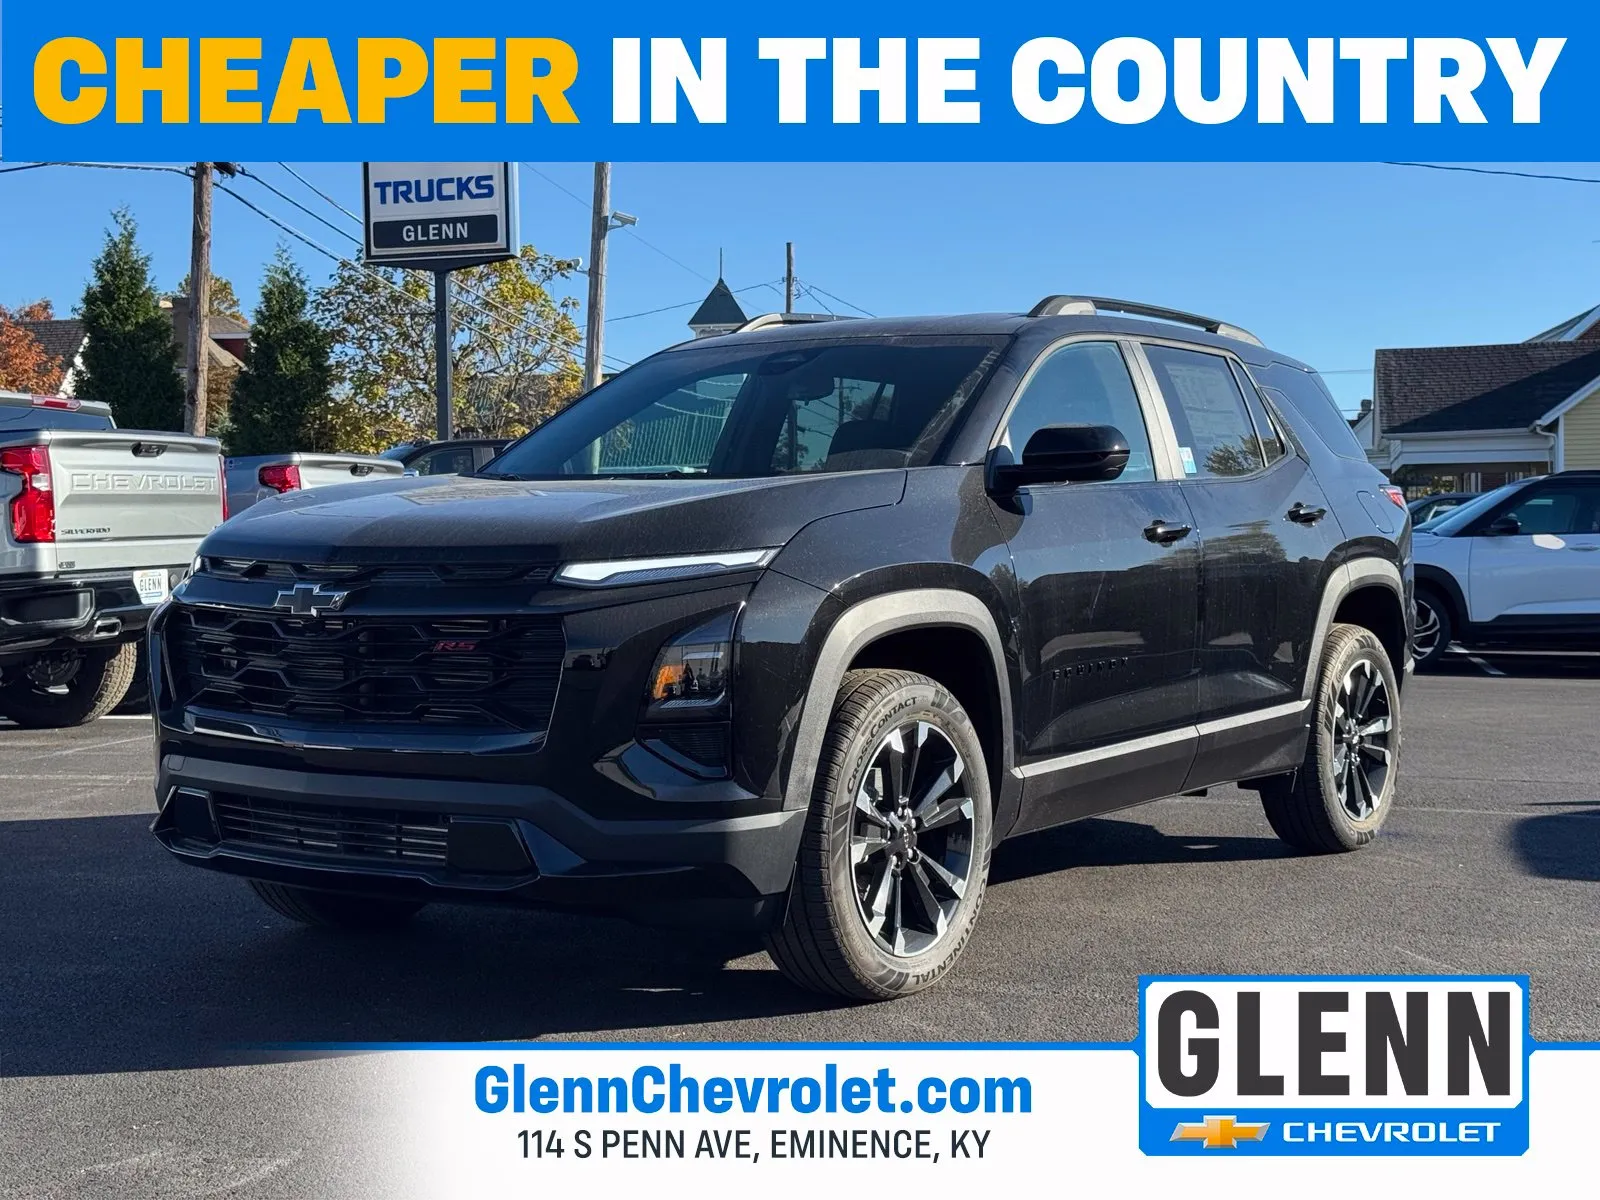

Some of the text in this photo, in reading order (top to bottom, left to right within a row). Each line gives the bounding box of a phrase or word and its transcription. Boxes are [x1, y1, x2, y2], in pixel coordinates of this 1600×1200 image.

[374, 175, 495, 205] TRUCKS
[402, 222, 468, 242] GLENN
[71, 473, 217, 491] CHEVROLET
[139, 577, 162, 591] GLENN
[433, 640, 477, 652] RS
[1052, 656, 1129, 680] EQUINOX
[912, 878, 986, 986] CONTINENTAL
